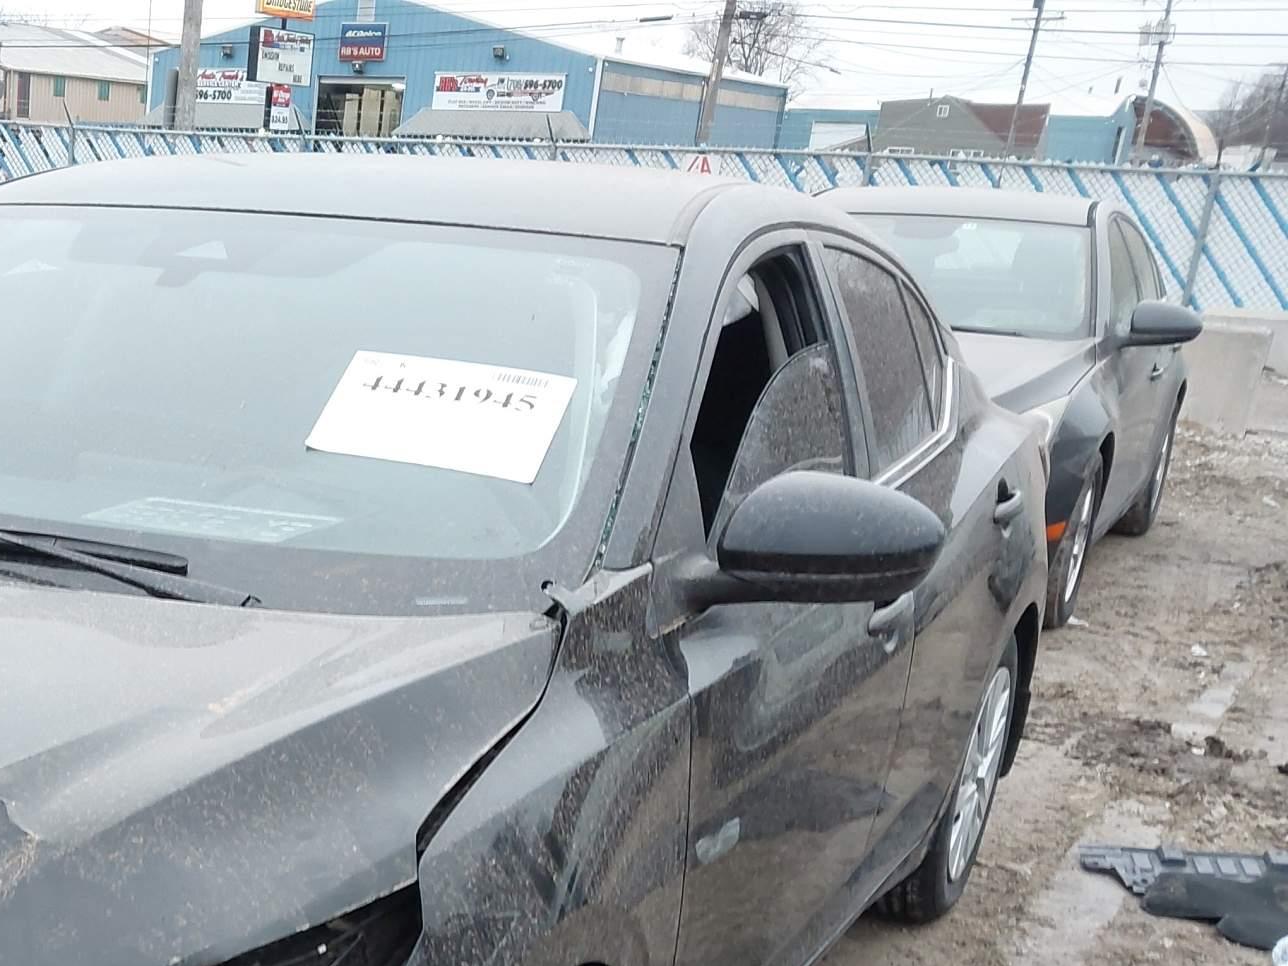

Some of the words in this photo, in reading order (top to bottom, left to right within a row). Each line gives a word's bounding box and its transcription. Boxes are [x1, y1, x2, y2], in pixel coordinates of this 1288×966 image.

[359, 46, 381, 56] AUTO
[524, 79, 563, 90] 596-5700
[362, 375, 537, 412] 44431945
